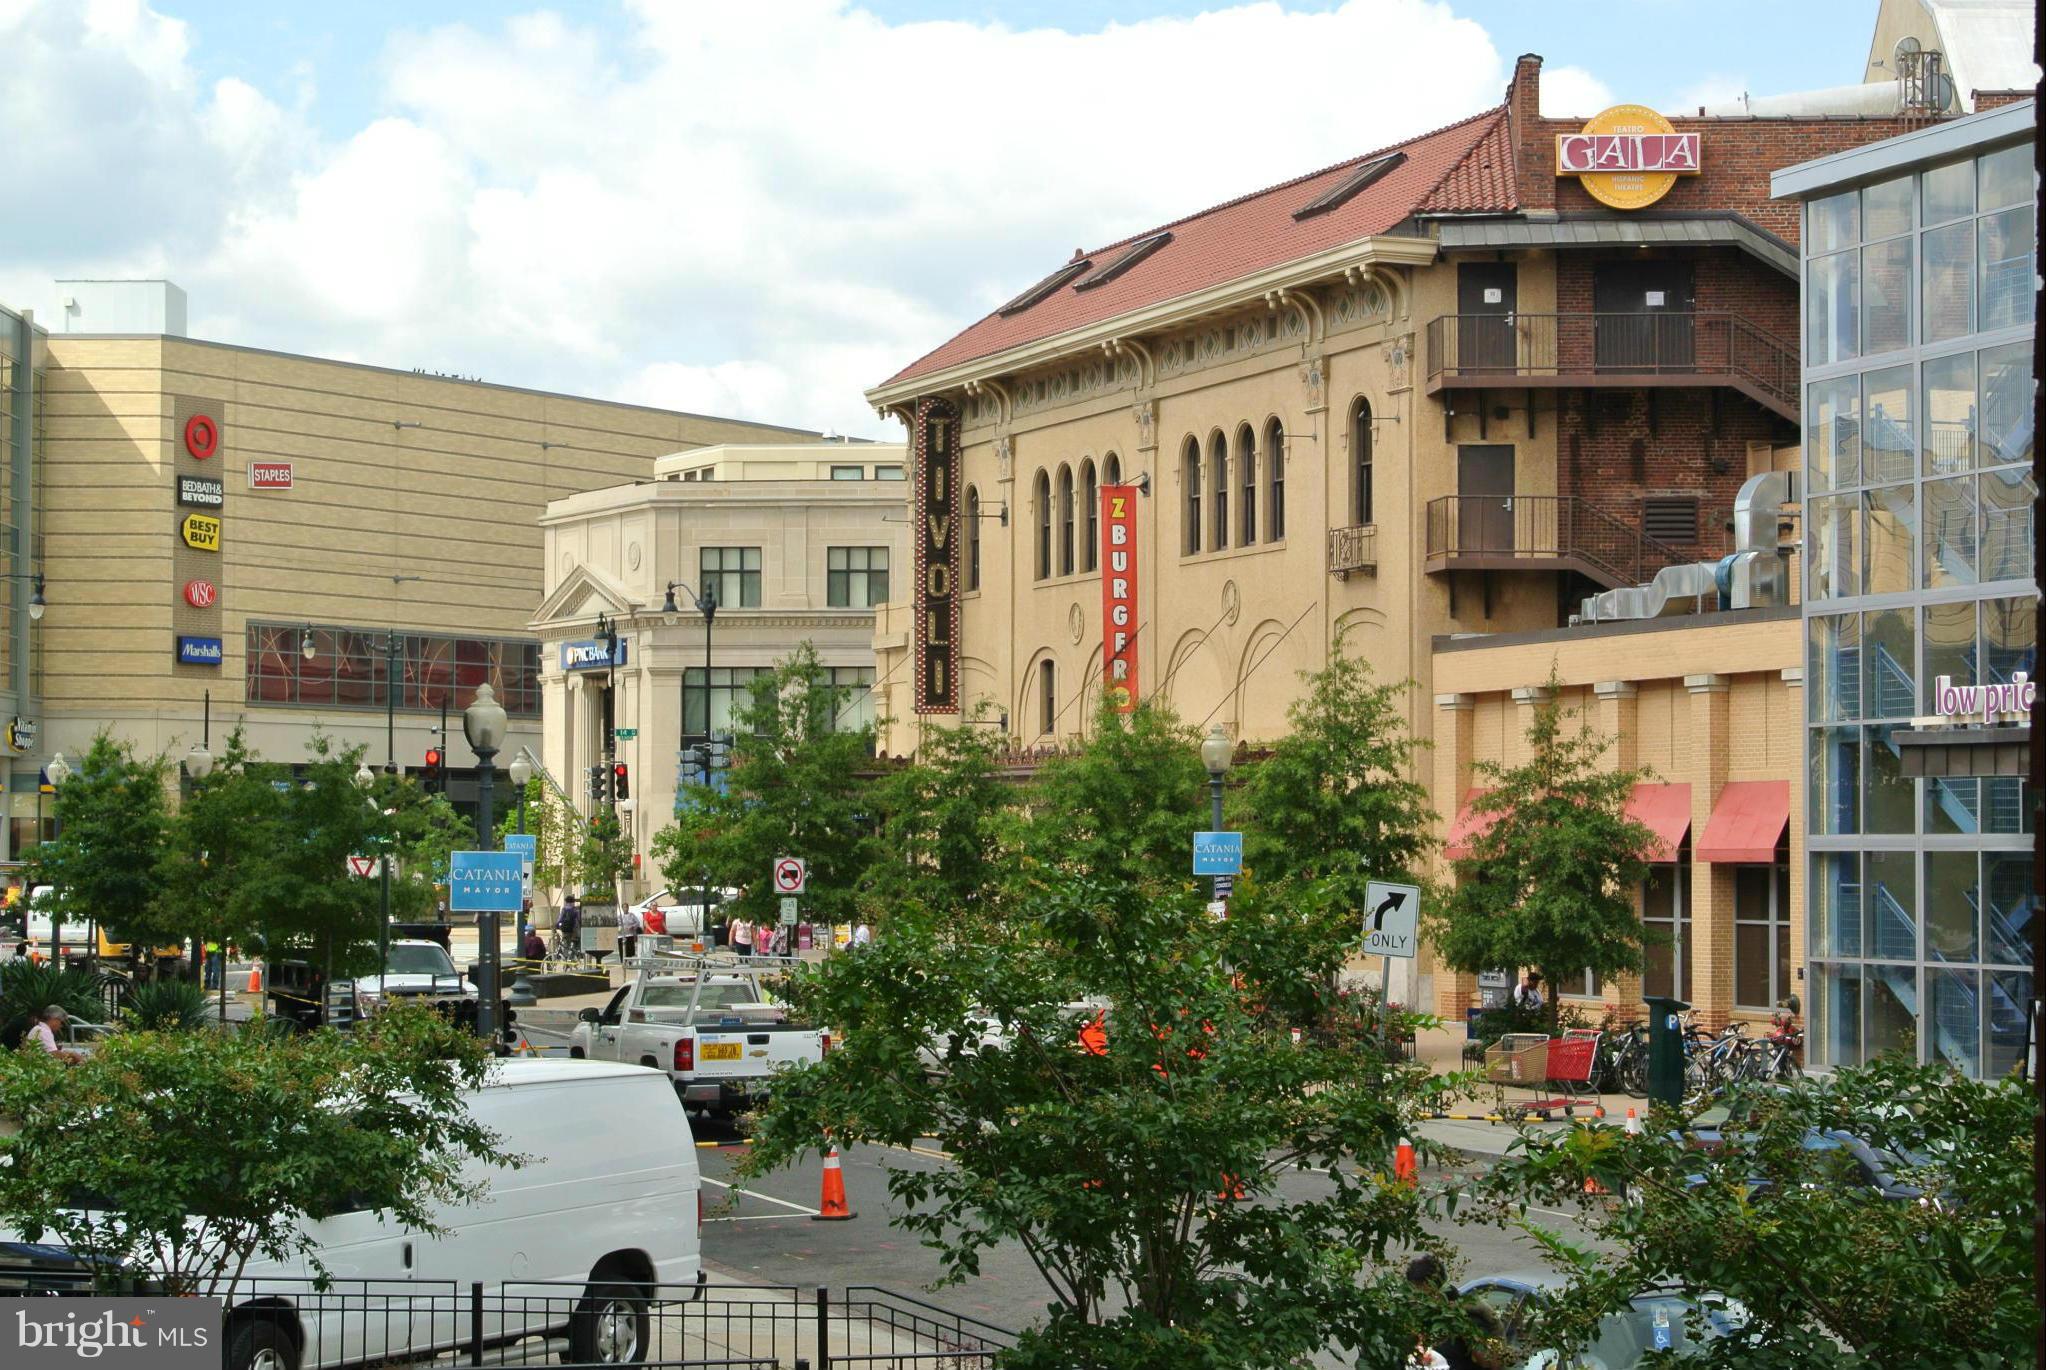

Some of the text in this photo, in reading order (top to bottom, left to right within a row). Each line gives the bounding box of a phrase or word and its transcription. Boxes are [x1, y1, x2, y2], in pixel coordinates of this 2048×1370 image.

[1561, 135, 1697, 170] GALA
[254, 469, 290, 482] STAPLES
[182, 480, 196, 491] BED
[197, 481, 216, 494] BATH
[182, 492, 222, 504] BEYOND
[190, 519, 218, 533] BEST
[190, 531, 215, 545] BUY
[926, 417, 950, 695] TIVOLI
[191, 582, 213, 605] WSC
[1111, 498, 1128, 680] Z BURGER
[182, 643, 221, 658] Marshalls
[1936, 675, 1977, 715] low
[1195, 844, 1241, 853] CATANIA
[453, 868, 521, 881] CATANIA
[1371, 933, 1407, 949] ONLY
